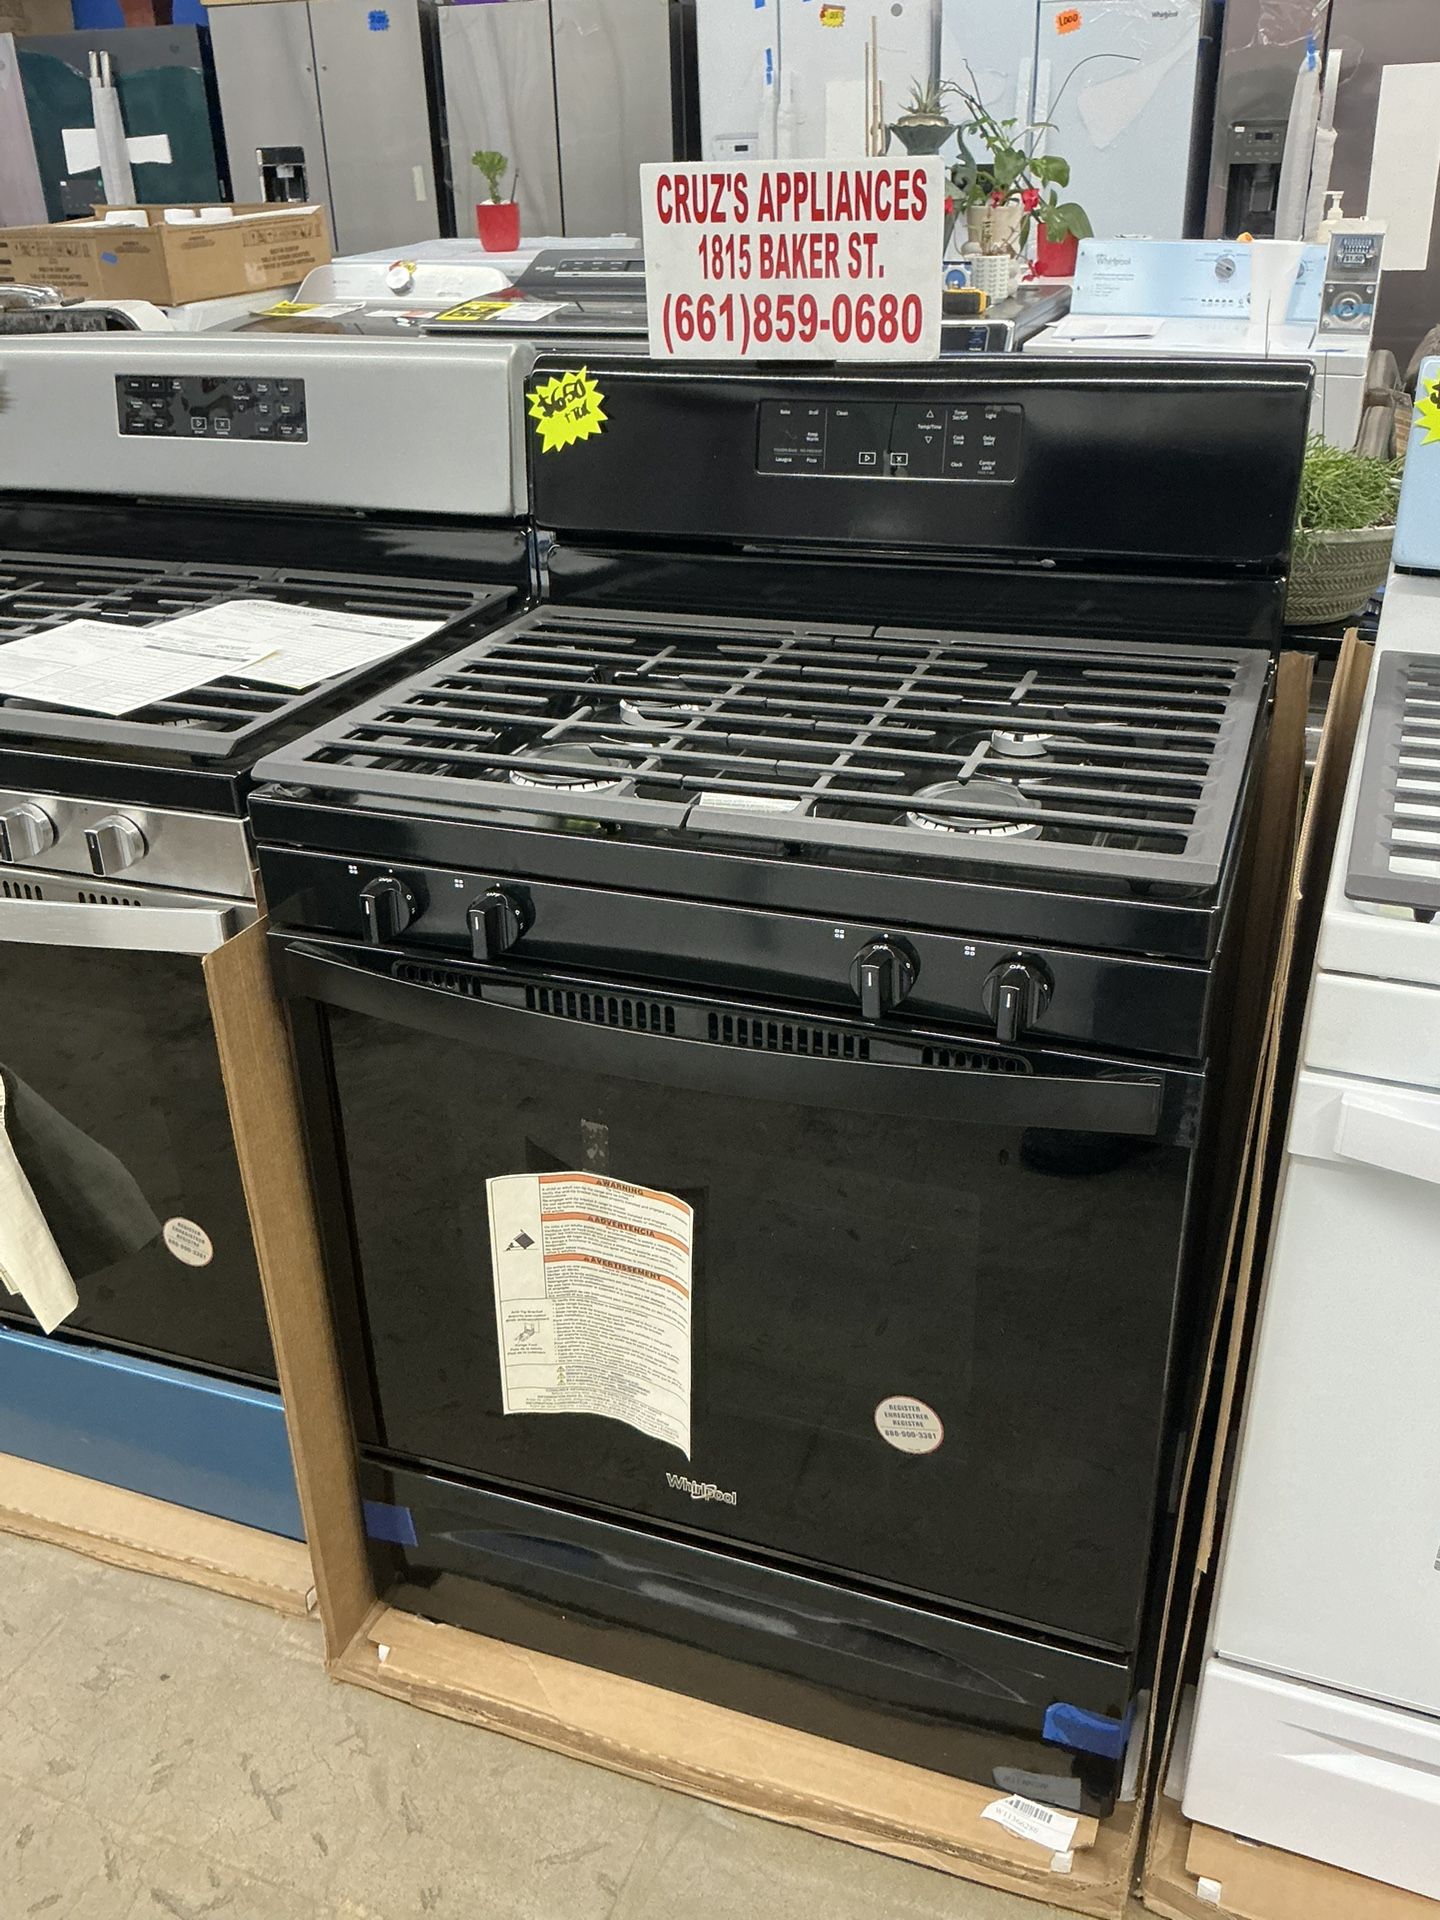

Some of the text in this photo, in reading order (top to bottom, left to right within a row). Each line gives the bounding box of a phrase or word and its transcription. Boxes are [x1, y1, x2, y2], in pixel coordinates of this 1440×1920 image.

[656, 168, 928, 225] CRUZ'S APPLIANCES
[698, 231, 885, 281] 1815 BAKER ST.
[662, 292, 924, 356] (661)859-0680
[602, 1180, 643, 1196] WARNING
[594, 1216, 655, 1238] ADVERTENCIA
[591, 1257, 663, 1281] AVERTISSEMENT
[884, 1411, 929, 1420] ENREGISTRER
[888, 1404, 921, 1412] REGISTER
[665, 1472, 737, 1506] Whirlpool
